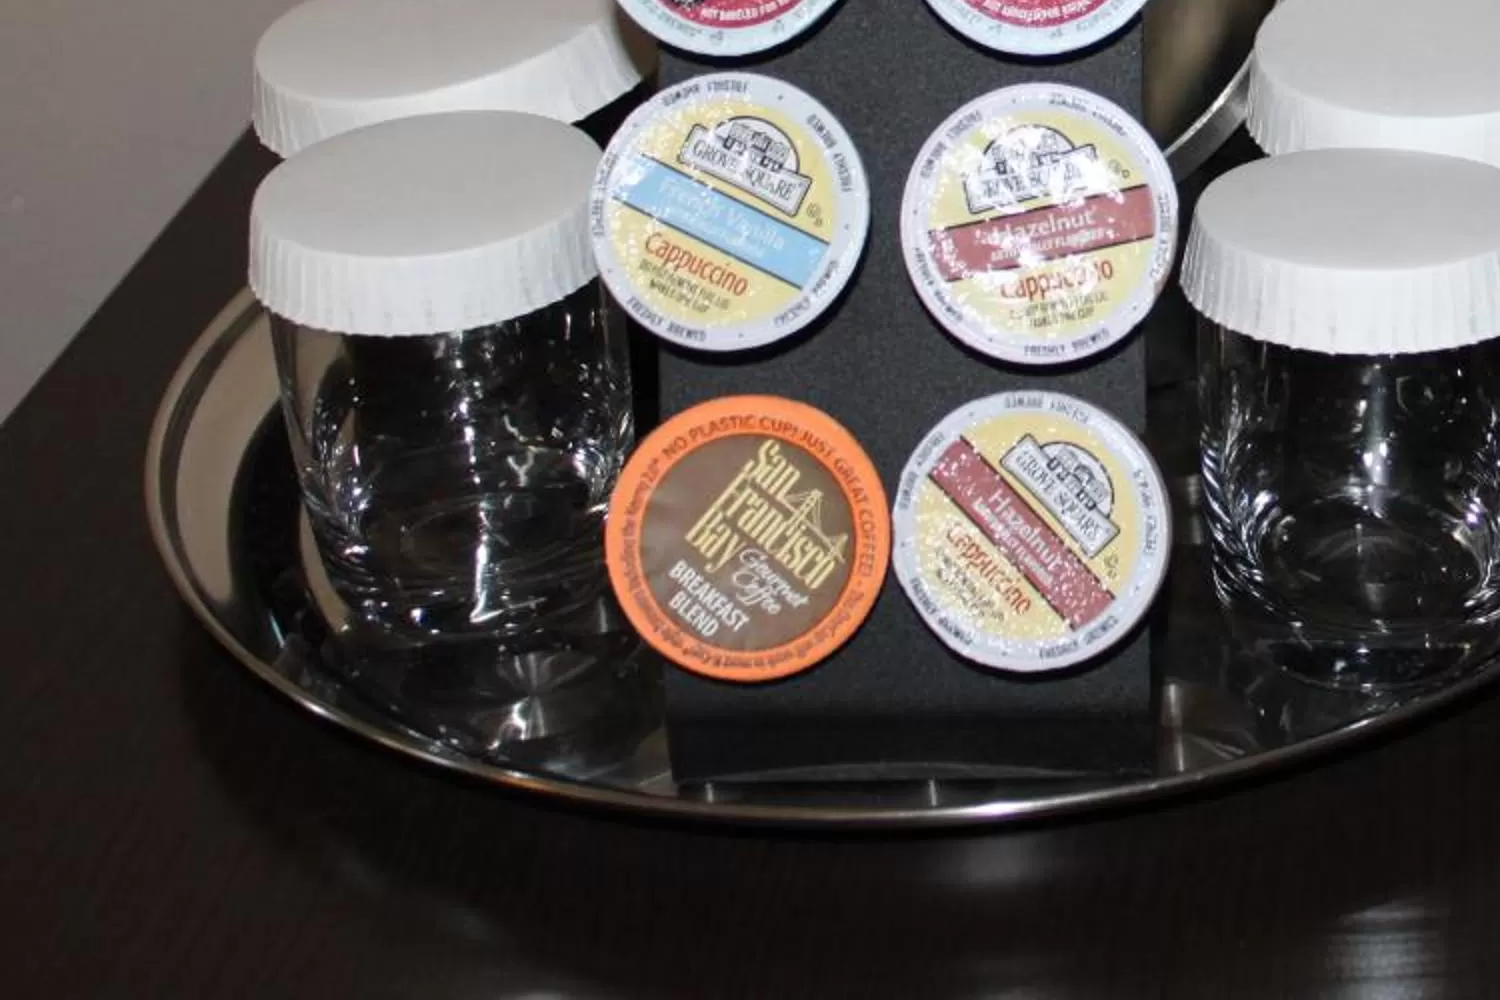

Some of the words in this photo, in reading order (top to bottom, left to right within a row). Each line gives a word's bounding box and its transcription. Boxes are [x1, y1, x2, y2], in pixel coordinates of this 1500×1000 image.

[692, 139, 737, 174] GROVE
[744, 164, 797, 202] SQUARE
[645, 231, 749, 297] Cappuccino
[662, 432, 688, 457] NO
[688, 415, 755, 442] PLASTIC
[799, 426, 834, 458] JUST
[832, 457, 868, 505] GREAT
[748, 438, 801, 500] San
[1013, 450, 1056, 497] GROVE
[684, 505, 747, 573] Bay
[738, 547, 810, 607] Gourmet
[712, 468, 836, 590] Francisco
[988, 489, 1061, 571] Hazelnut
[668, 559, 749, 632] BREAKFAST
[731, 567, 782, 615] Coffee
[946, 521, 1031, 615] Cappuccino
[668, 591, 720, 638] BLEND
